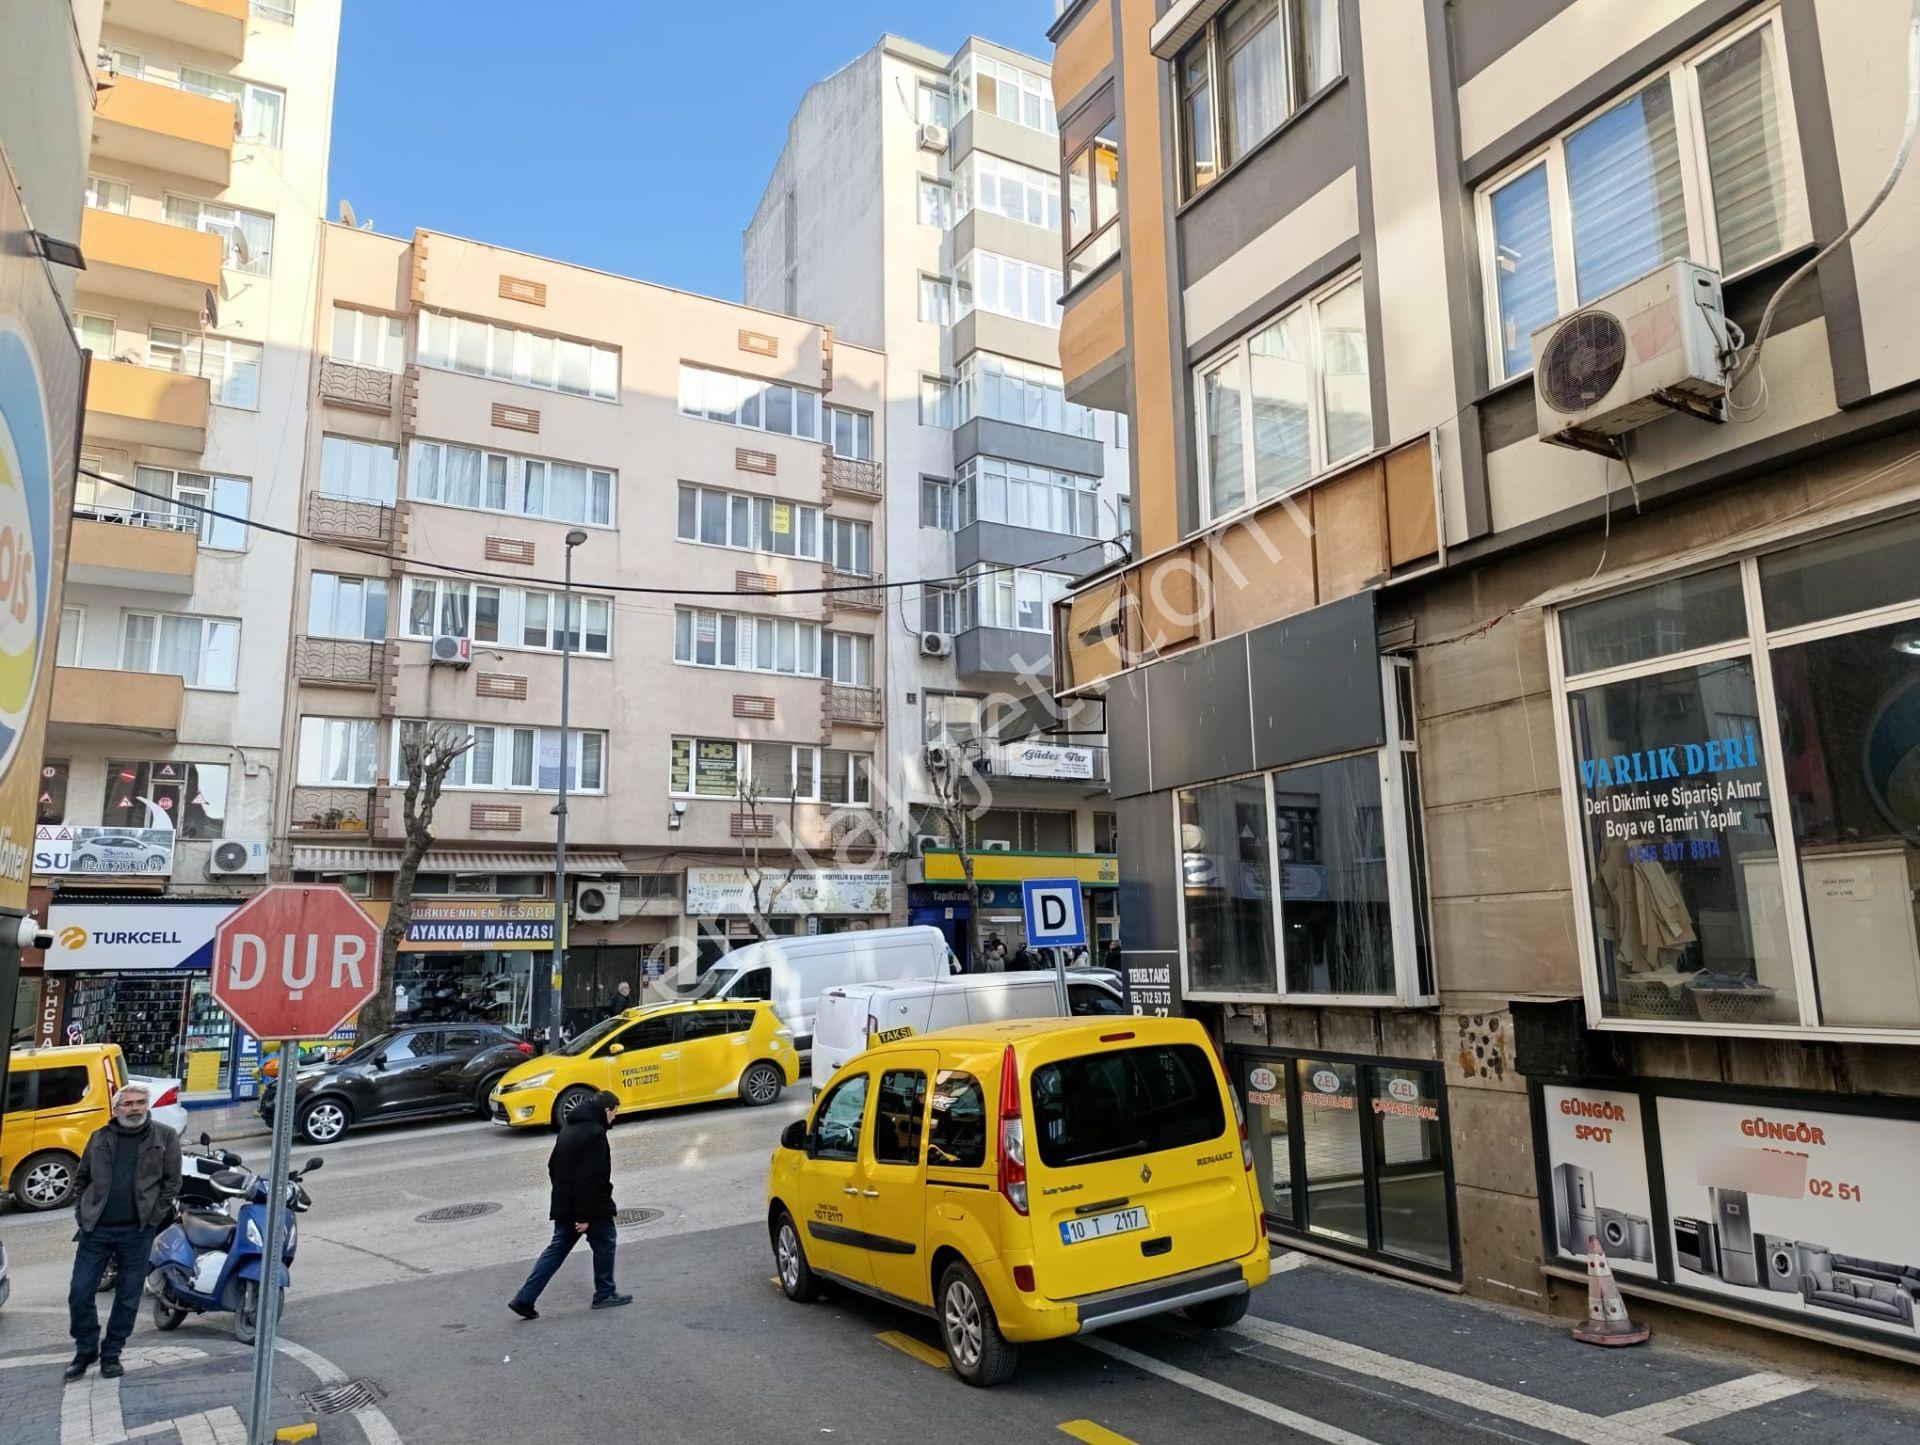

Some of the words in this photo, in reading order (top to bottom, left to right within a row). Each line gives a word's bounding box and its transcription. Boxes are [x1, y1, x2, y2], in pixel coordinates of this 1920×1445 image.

[1579, 746, 1679, 789] VARLIK
[1683, 735, 1758, 777] DERİ
[1585, 796, 1610, 816] Deri
[1612, 791, 1650, 813] Dikimi
[1653, 793, 1669, 808] ve
[1671, 782, 1723, 809] Siparişi
[1726, 780, 1762, 800] Alınır
[1605, 820, 1637, 840] Boya
[1639, 820, 1655, 834] ve
[1657, 812, 1699, 833] Tamiri
[1700, 808, 1742, 832] Yapılır
[481, 910, 494, 918] EN
[500, 905, 555, 918] HESAPLI
[1040, 894, 1067, 930] D
[92, 931, 181, 944] TURKCELL
[410, 924, 479, 940] AYAKKABI
[484, 921, 553, 939] MAĞAZASI
[228, 933, 366, 990] DUR
[1130, 991, 1141, 1004] TEL:
[1142, 991, 1153, 1004] 712
[1154, 992, 1162, 1004] 53
[1162, 992, 1171, 1005] 73
[880, 1028, 911, 1042] TAKSİ
[1253, 1072, 1272, 1086] 2.EL
[1317, 1075, 1336, 1089] 2.EL
[1393, 1083, 1414, 1097] 2.EL
[1560, 1098, 1625, 1121] GÜNGÖR
[1575, 1125, 1612, 1143] SPOT
[1741, 1118, 1825, 1145] GÜNGÖR
[1197, 1151, 1233, 1166] RENAULT
[1809, 1179, 1833, 1198] 02
[1838, 1183, 1860, 1202] 51
[1070, 1222, 1085, 1240] 10
[1092, 1218, 1100, 1234] T
[1114, 1210, 1139, 1230] 2117
